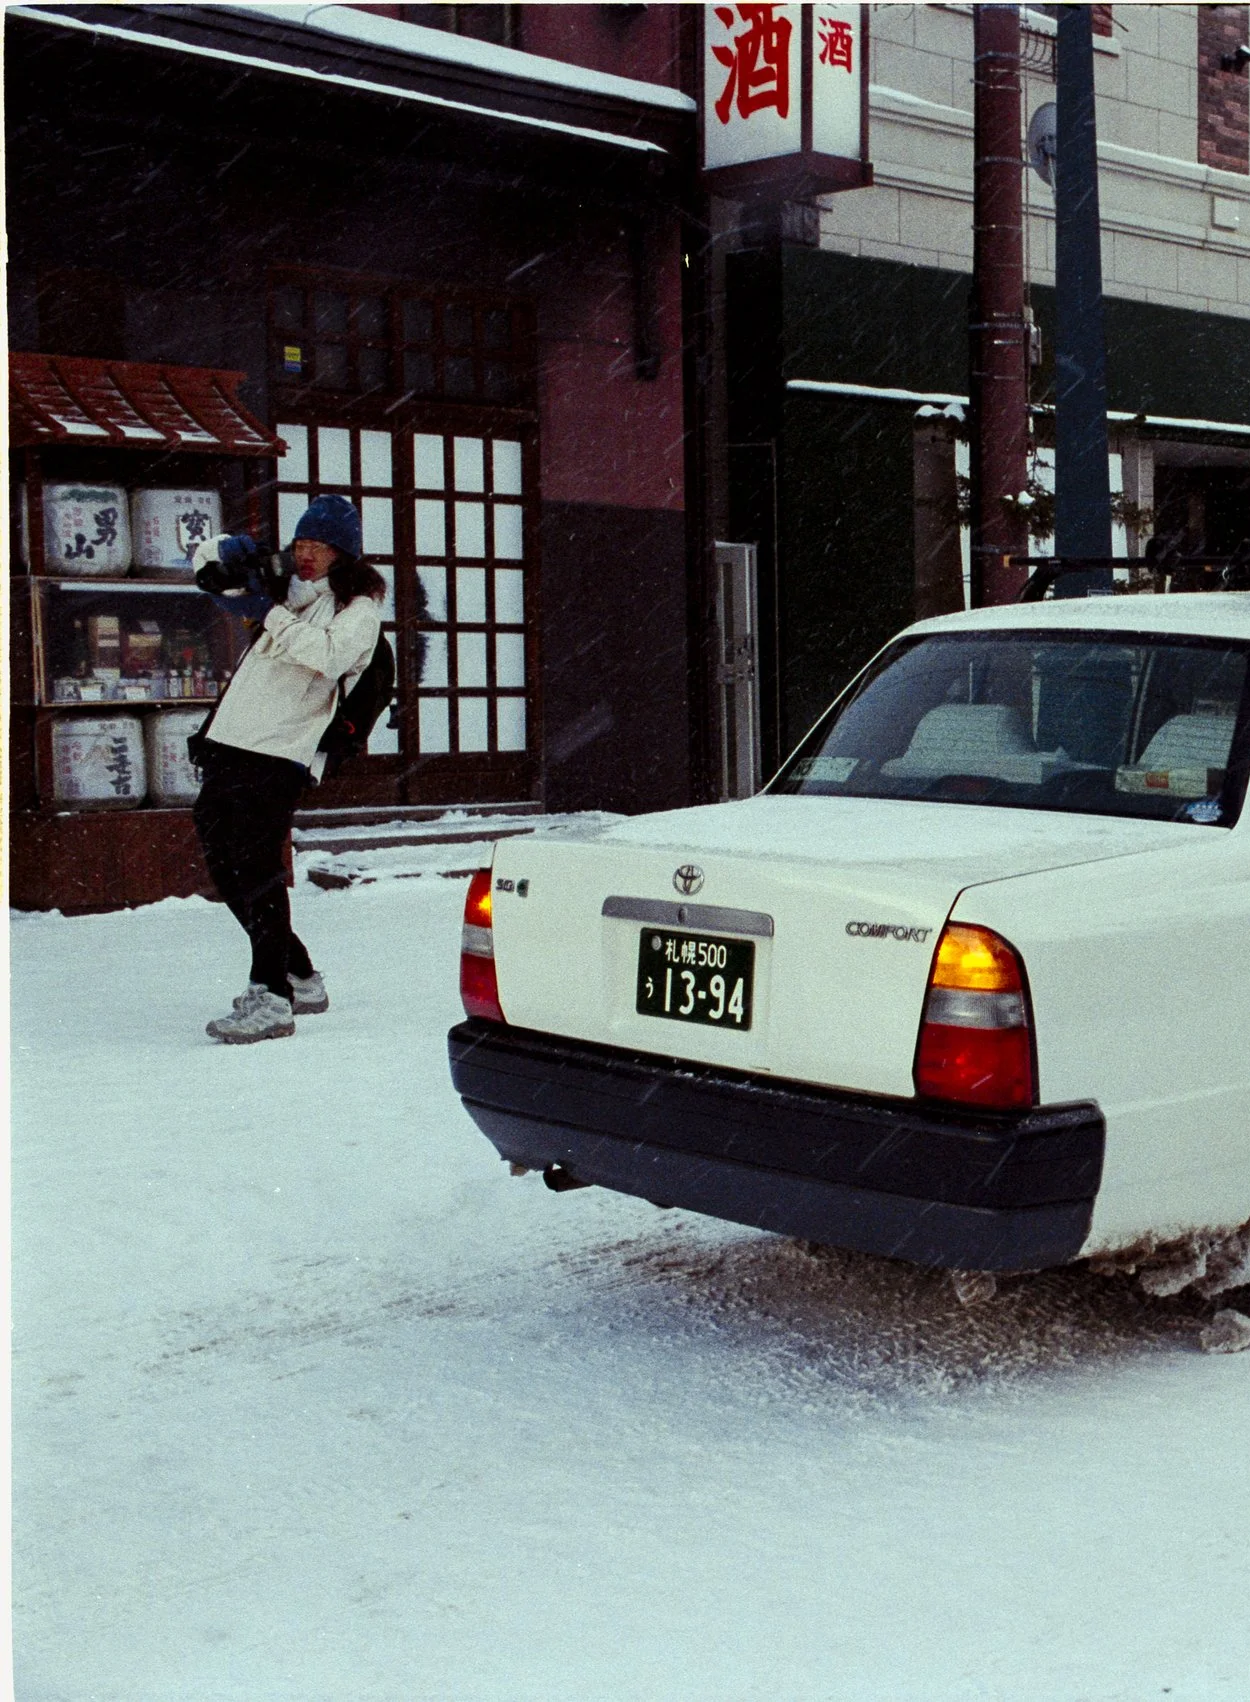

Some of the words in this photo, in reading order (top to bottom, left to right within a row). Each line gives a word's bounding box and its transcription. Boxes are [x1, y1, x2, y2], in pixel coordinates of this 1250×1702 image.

[711, 4, 792, 125] 酒
[818, 16, 853, 74] 酒
[64, 507, 119, 560] 男山
[665, 938, 728, 969] 札幌500
[845, 921, 931, 943] COMFORT
[645, 977, 655, 999] う
[664, 967, 745, 1024] 13-94
